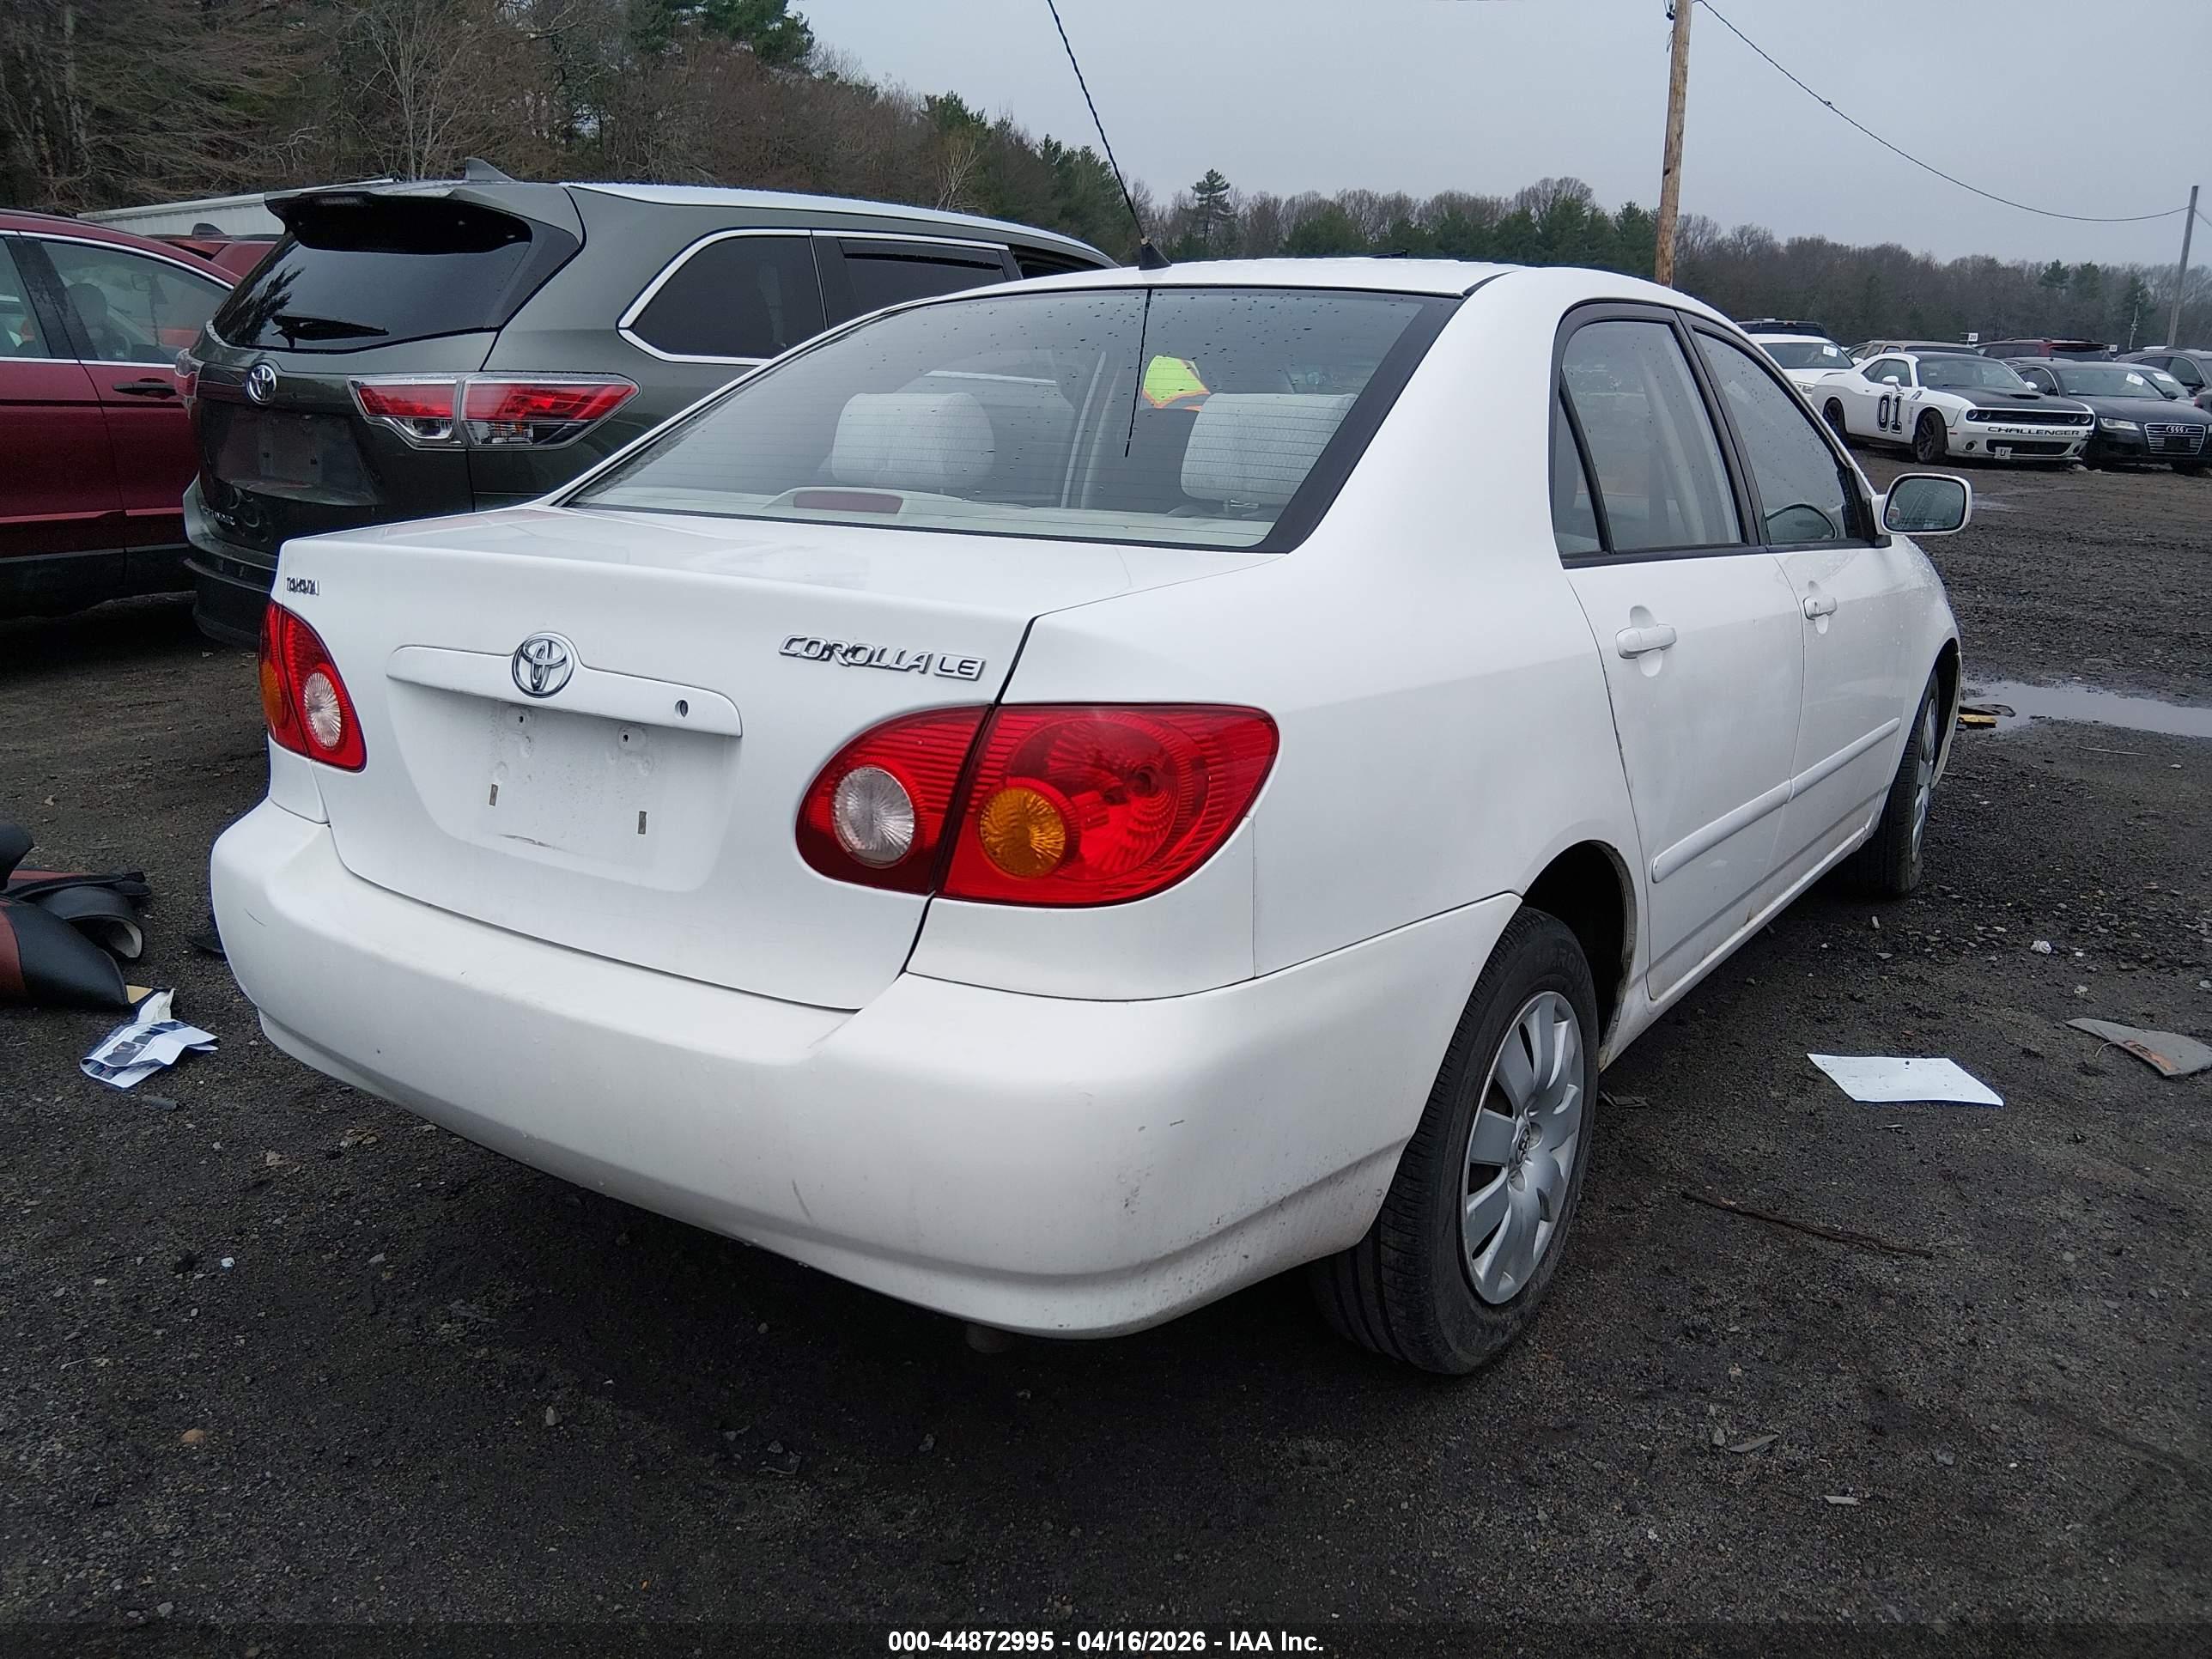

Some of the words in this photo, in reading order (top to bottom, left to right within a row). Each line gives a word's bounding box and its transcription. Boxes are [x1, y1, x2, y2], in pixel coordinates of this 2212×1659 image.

[1877, 391, 1905, 434] 01
[1987, 426, 2080, 436] CHALLENGER
[778, 634, 934, 674] COROLLA
[937, 655, 981, 678] LE
